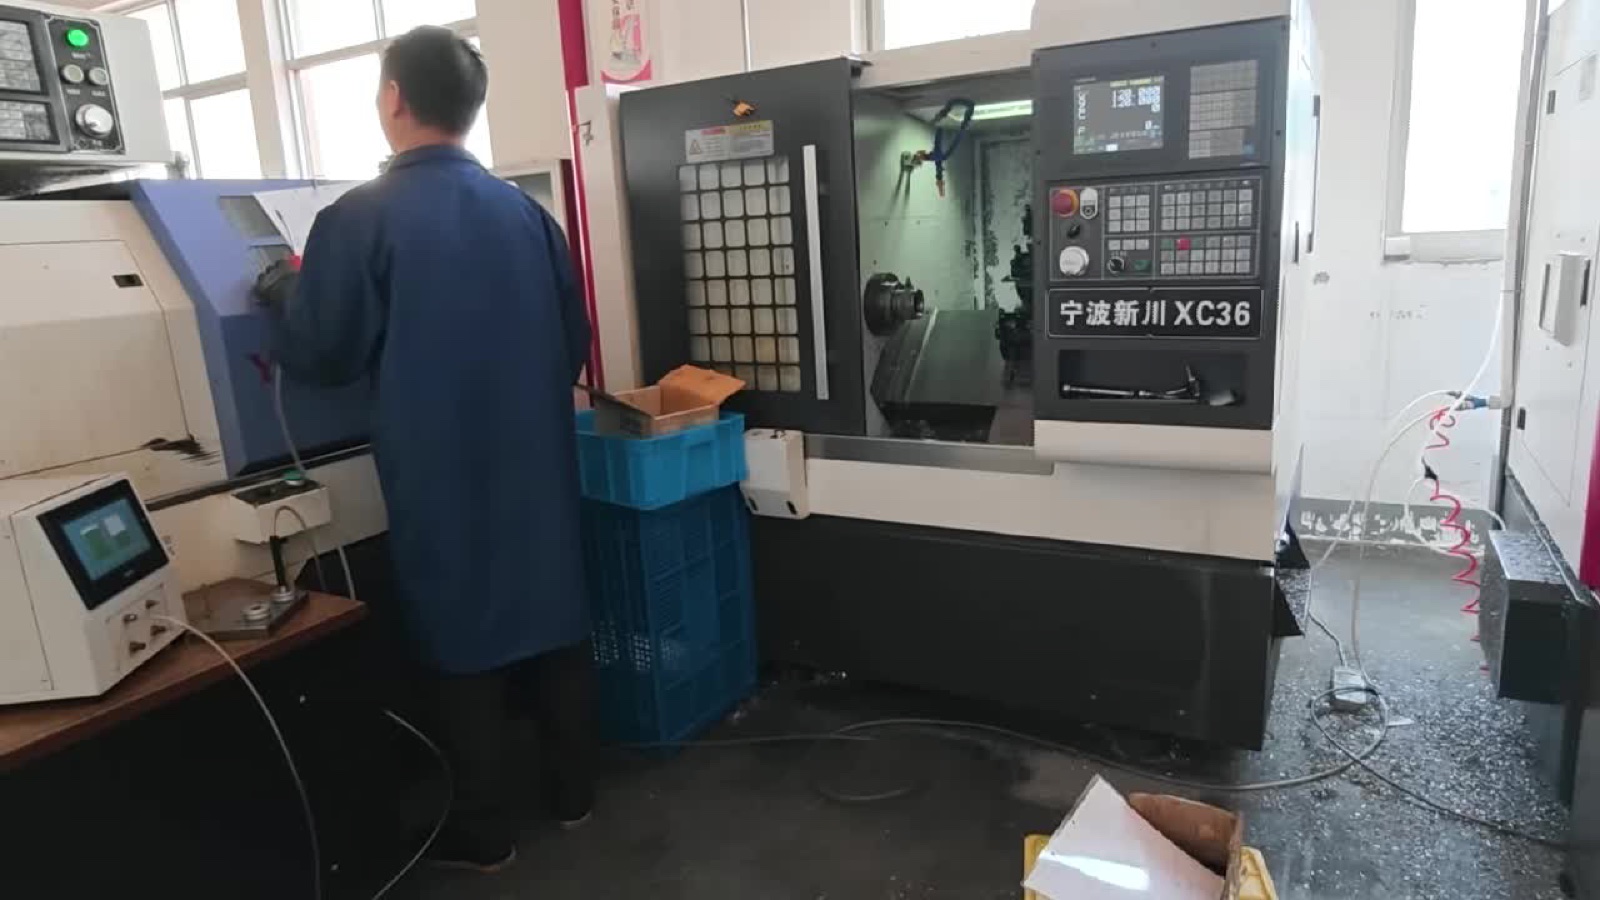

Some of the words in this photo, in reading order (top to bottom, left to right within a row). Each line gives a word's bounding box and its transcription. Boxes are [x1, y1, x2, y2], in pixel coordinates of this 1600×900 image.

[1060, 300, 1166, 326] 宁波新川
[1173, 300, 1251, 326] XC36
